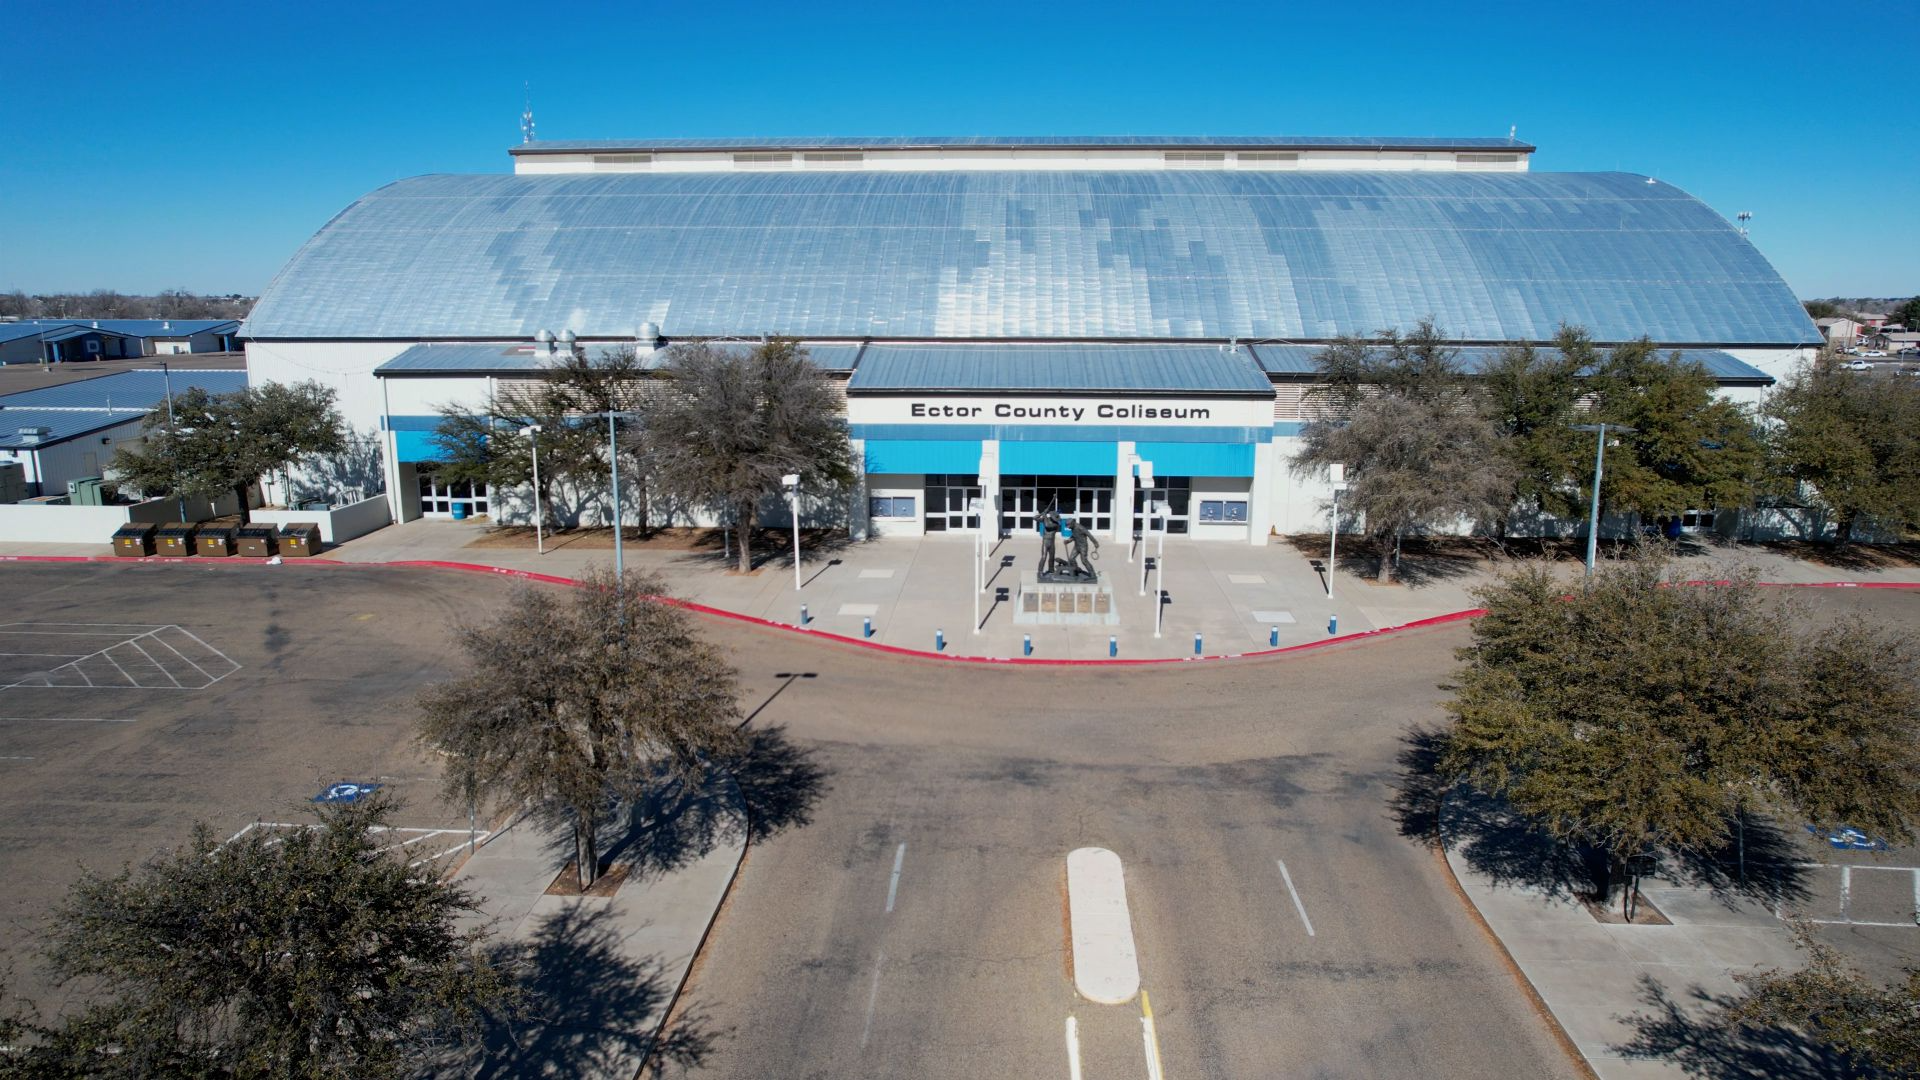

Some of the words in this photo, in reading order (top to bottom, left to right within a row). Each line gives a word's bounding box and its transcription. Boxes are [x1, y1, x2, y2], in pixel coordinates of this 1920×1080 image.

[912, 404, 981, 417] Ector
[995, 404, 1084, 421] County
[1098, 405, 1209, 418] Coliseum
